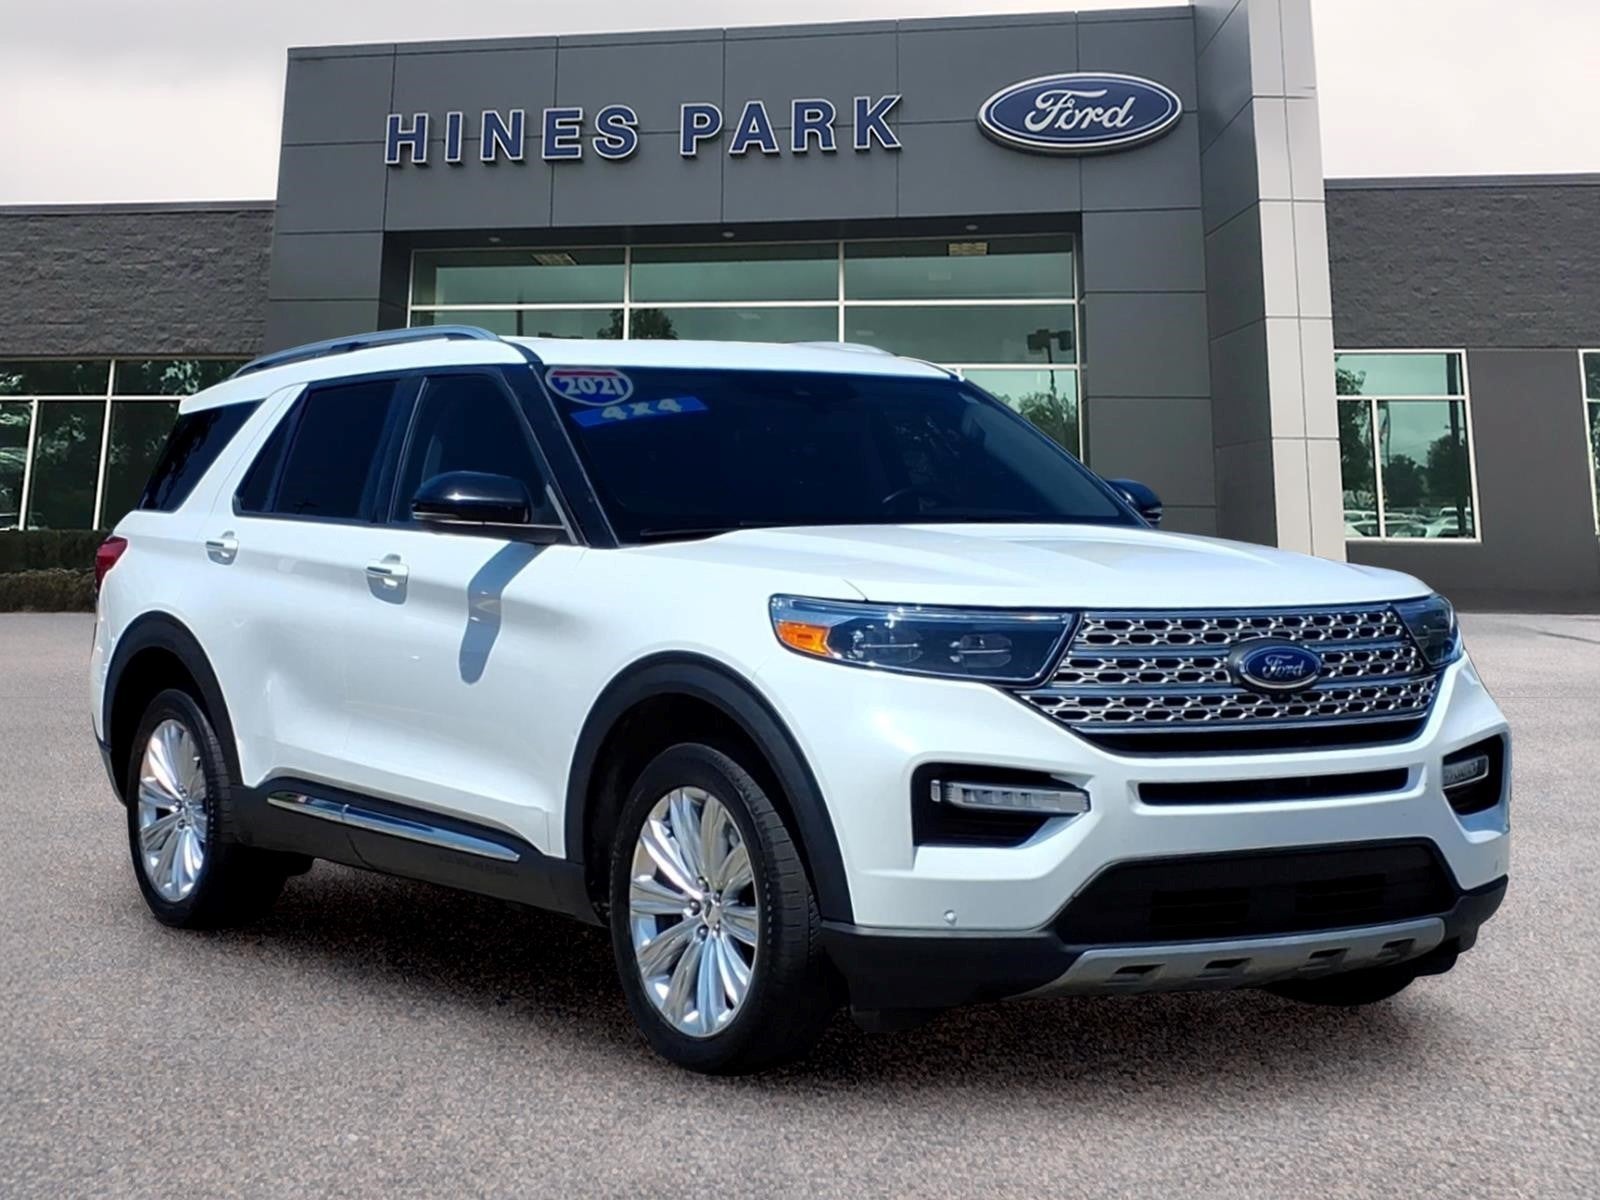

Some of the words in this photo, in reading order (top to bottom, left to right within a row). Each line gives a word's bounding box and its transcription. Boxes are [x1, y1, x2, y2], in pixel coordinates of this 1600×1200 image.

[1024, 89, 1136, 132] Ford
[384, 104, 639, 165] HINES
[679, 94, 903, 157] PARK
[559, 377, 625, 396] 2021
[1262, 654, 1305, 678] Ford
